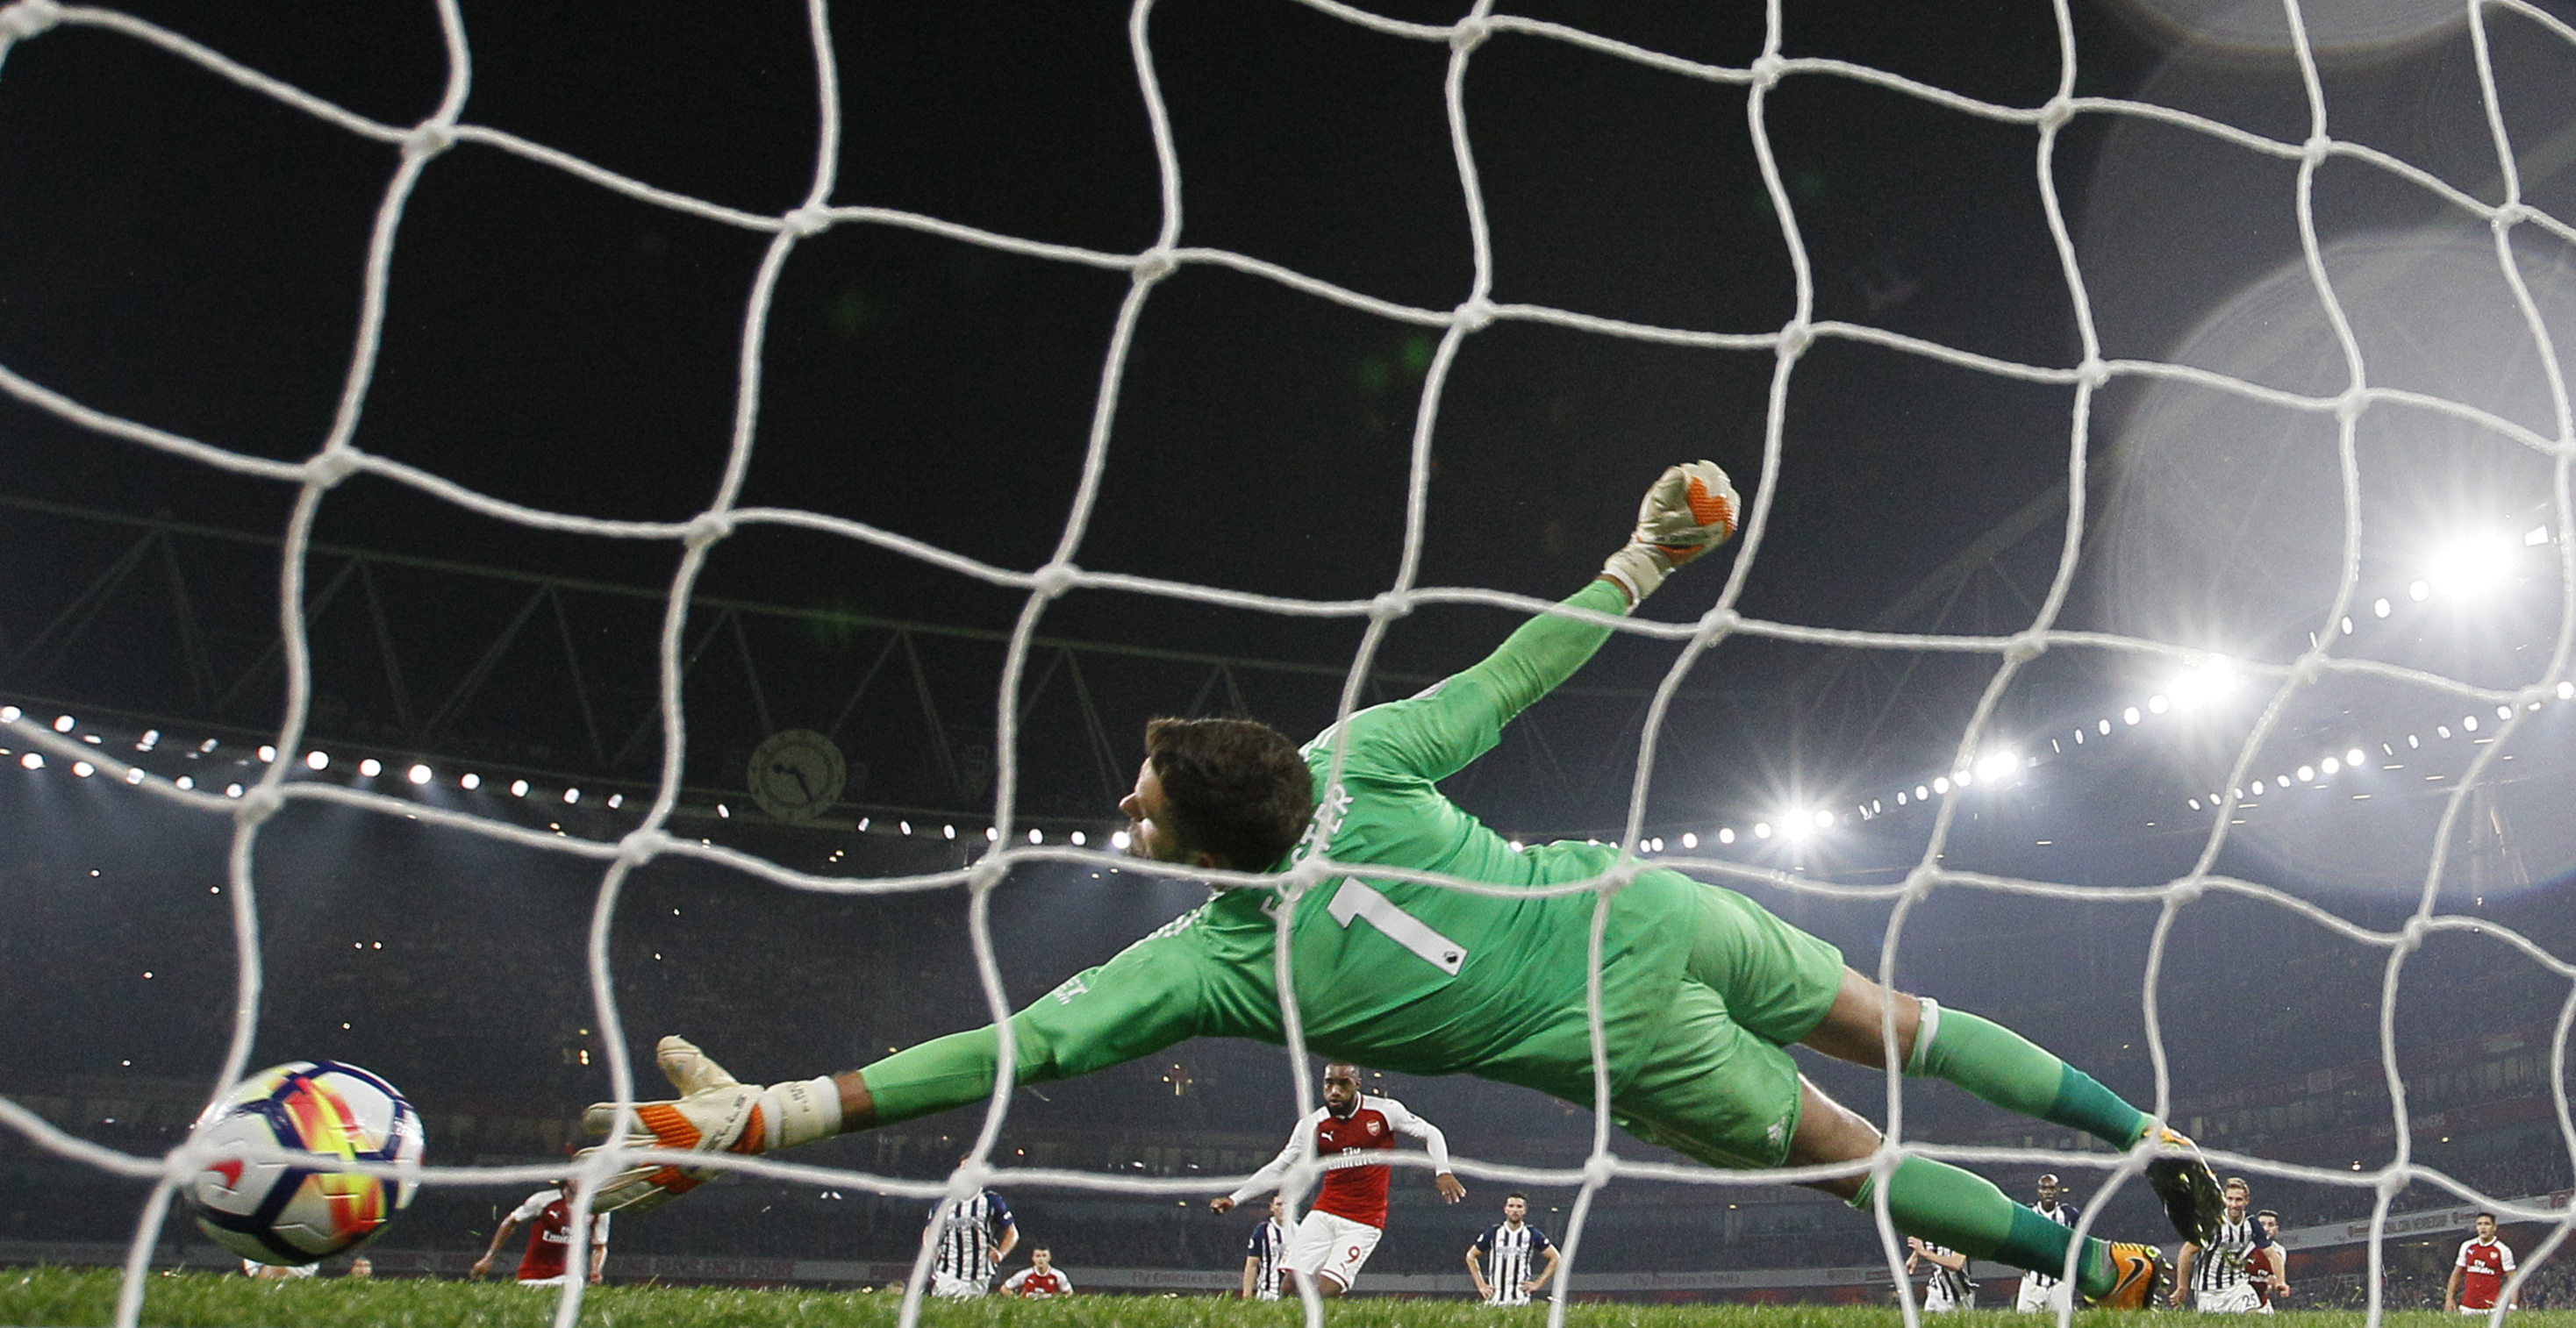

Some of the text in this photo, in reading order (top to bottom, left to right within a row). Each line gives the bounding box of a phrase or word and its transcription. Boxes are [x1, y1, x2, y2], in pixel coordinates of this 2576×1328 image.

[1327, 875, 1469, 977] 1
[1347, 1246, 1361, 1264] 9
[2242, 1293, 2258, 1308] 25
